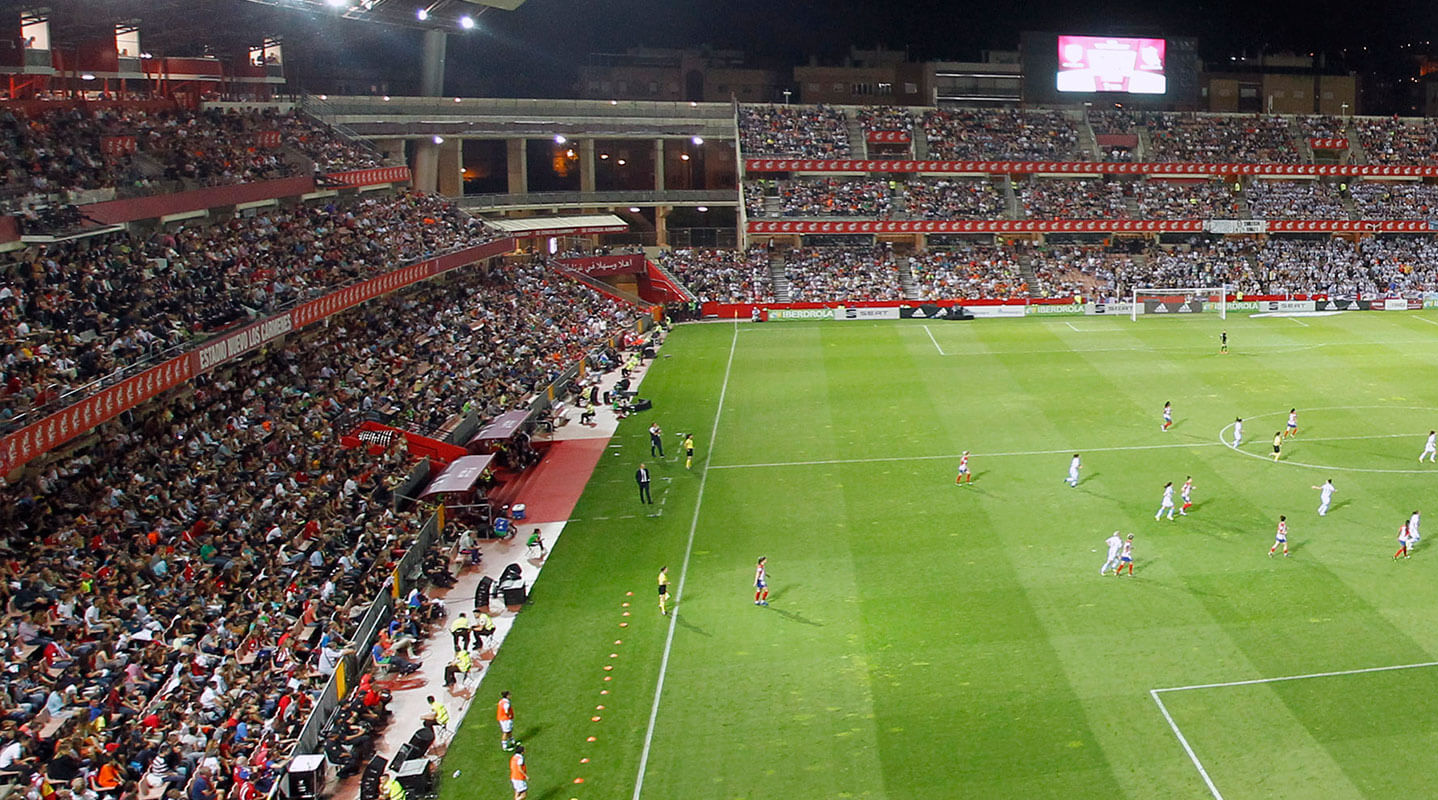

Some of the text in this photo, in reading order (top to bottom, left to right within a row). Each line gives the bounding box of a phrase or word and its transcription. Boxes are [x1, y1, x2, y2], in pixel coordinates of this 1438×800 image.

[1038, 305, 1084, 313] IBERDROLA
[783, 310, 833, 318] IBERDROLA
[200, 340, 227, 369] ESTADIO
[227, 330, 248, 357] NUEVO
[248, 326, 261, 347] LOS
